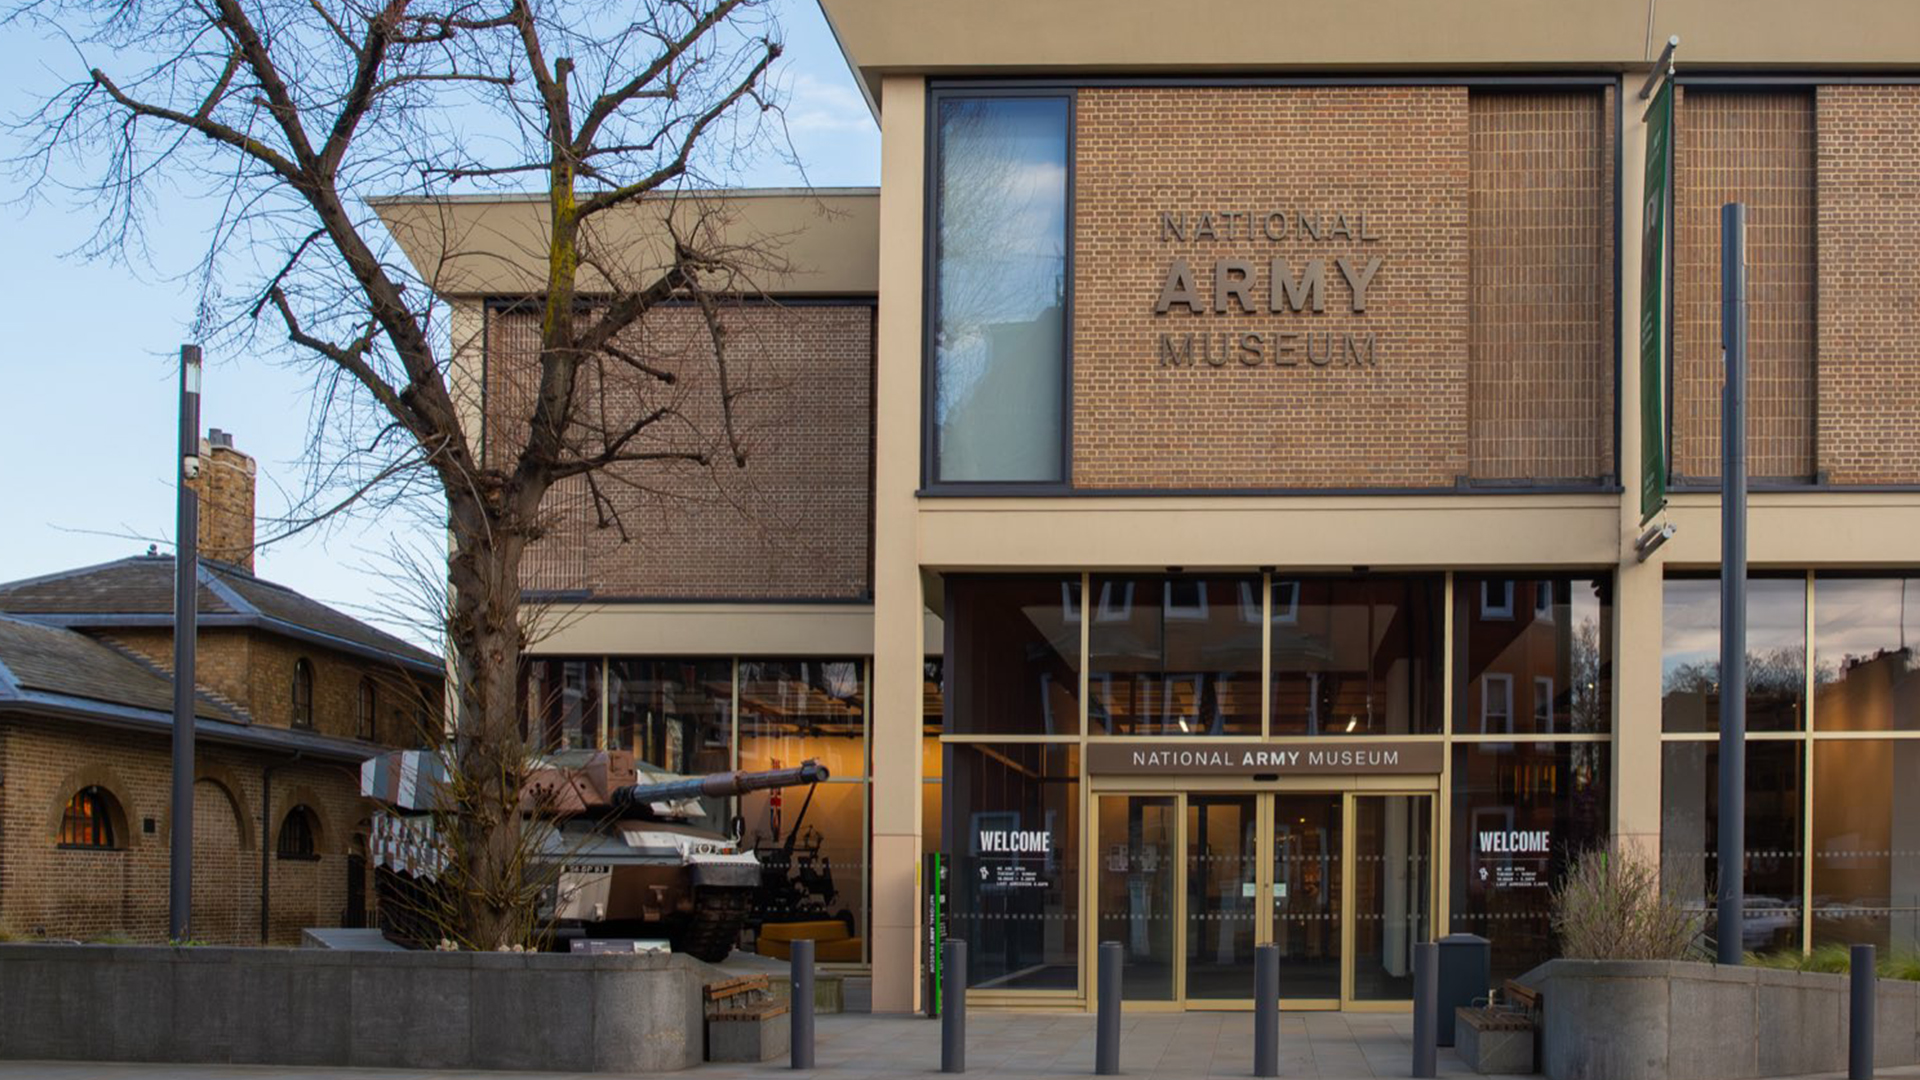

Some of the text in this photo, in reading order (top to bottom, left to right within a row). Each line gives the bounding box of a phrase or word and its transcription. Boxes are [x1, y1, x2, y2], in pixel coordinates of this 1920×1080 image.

[1161, 210, 1381, 242] NATIONAL
[1155, 257, 1383, 315] ARMY
[1161, 331, 1377, 368] MUSEUM
[1133, 750, 1399, 766] NATIONAL ARMY MUSEUM
[980, 831, 1050, 852] WELCOME
[1479, 831, 1550, 852] WELCOME
